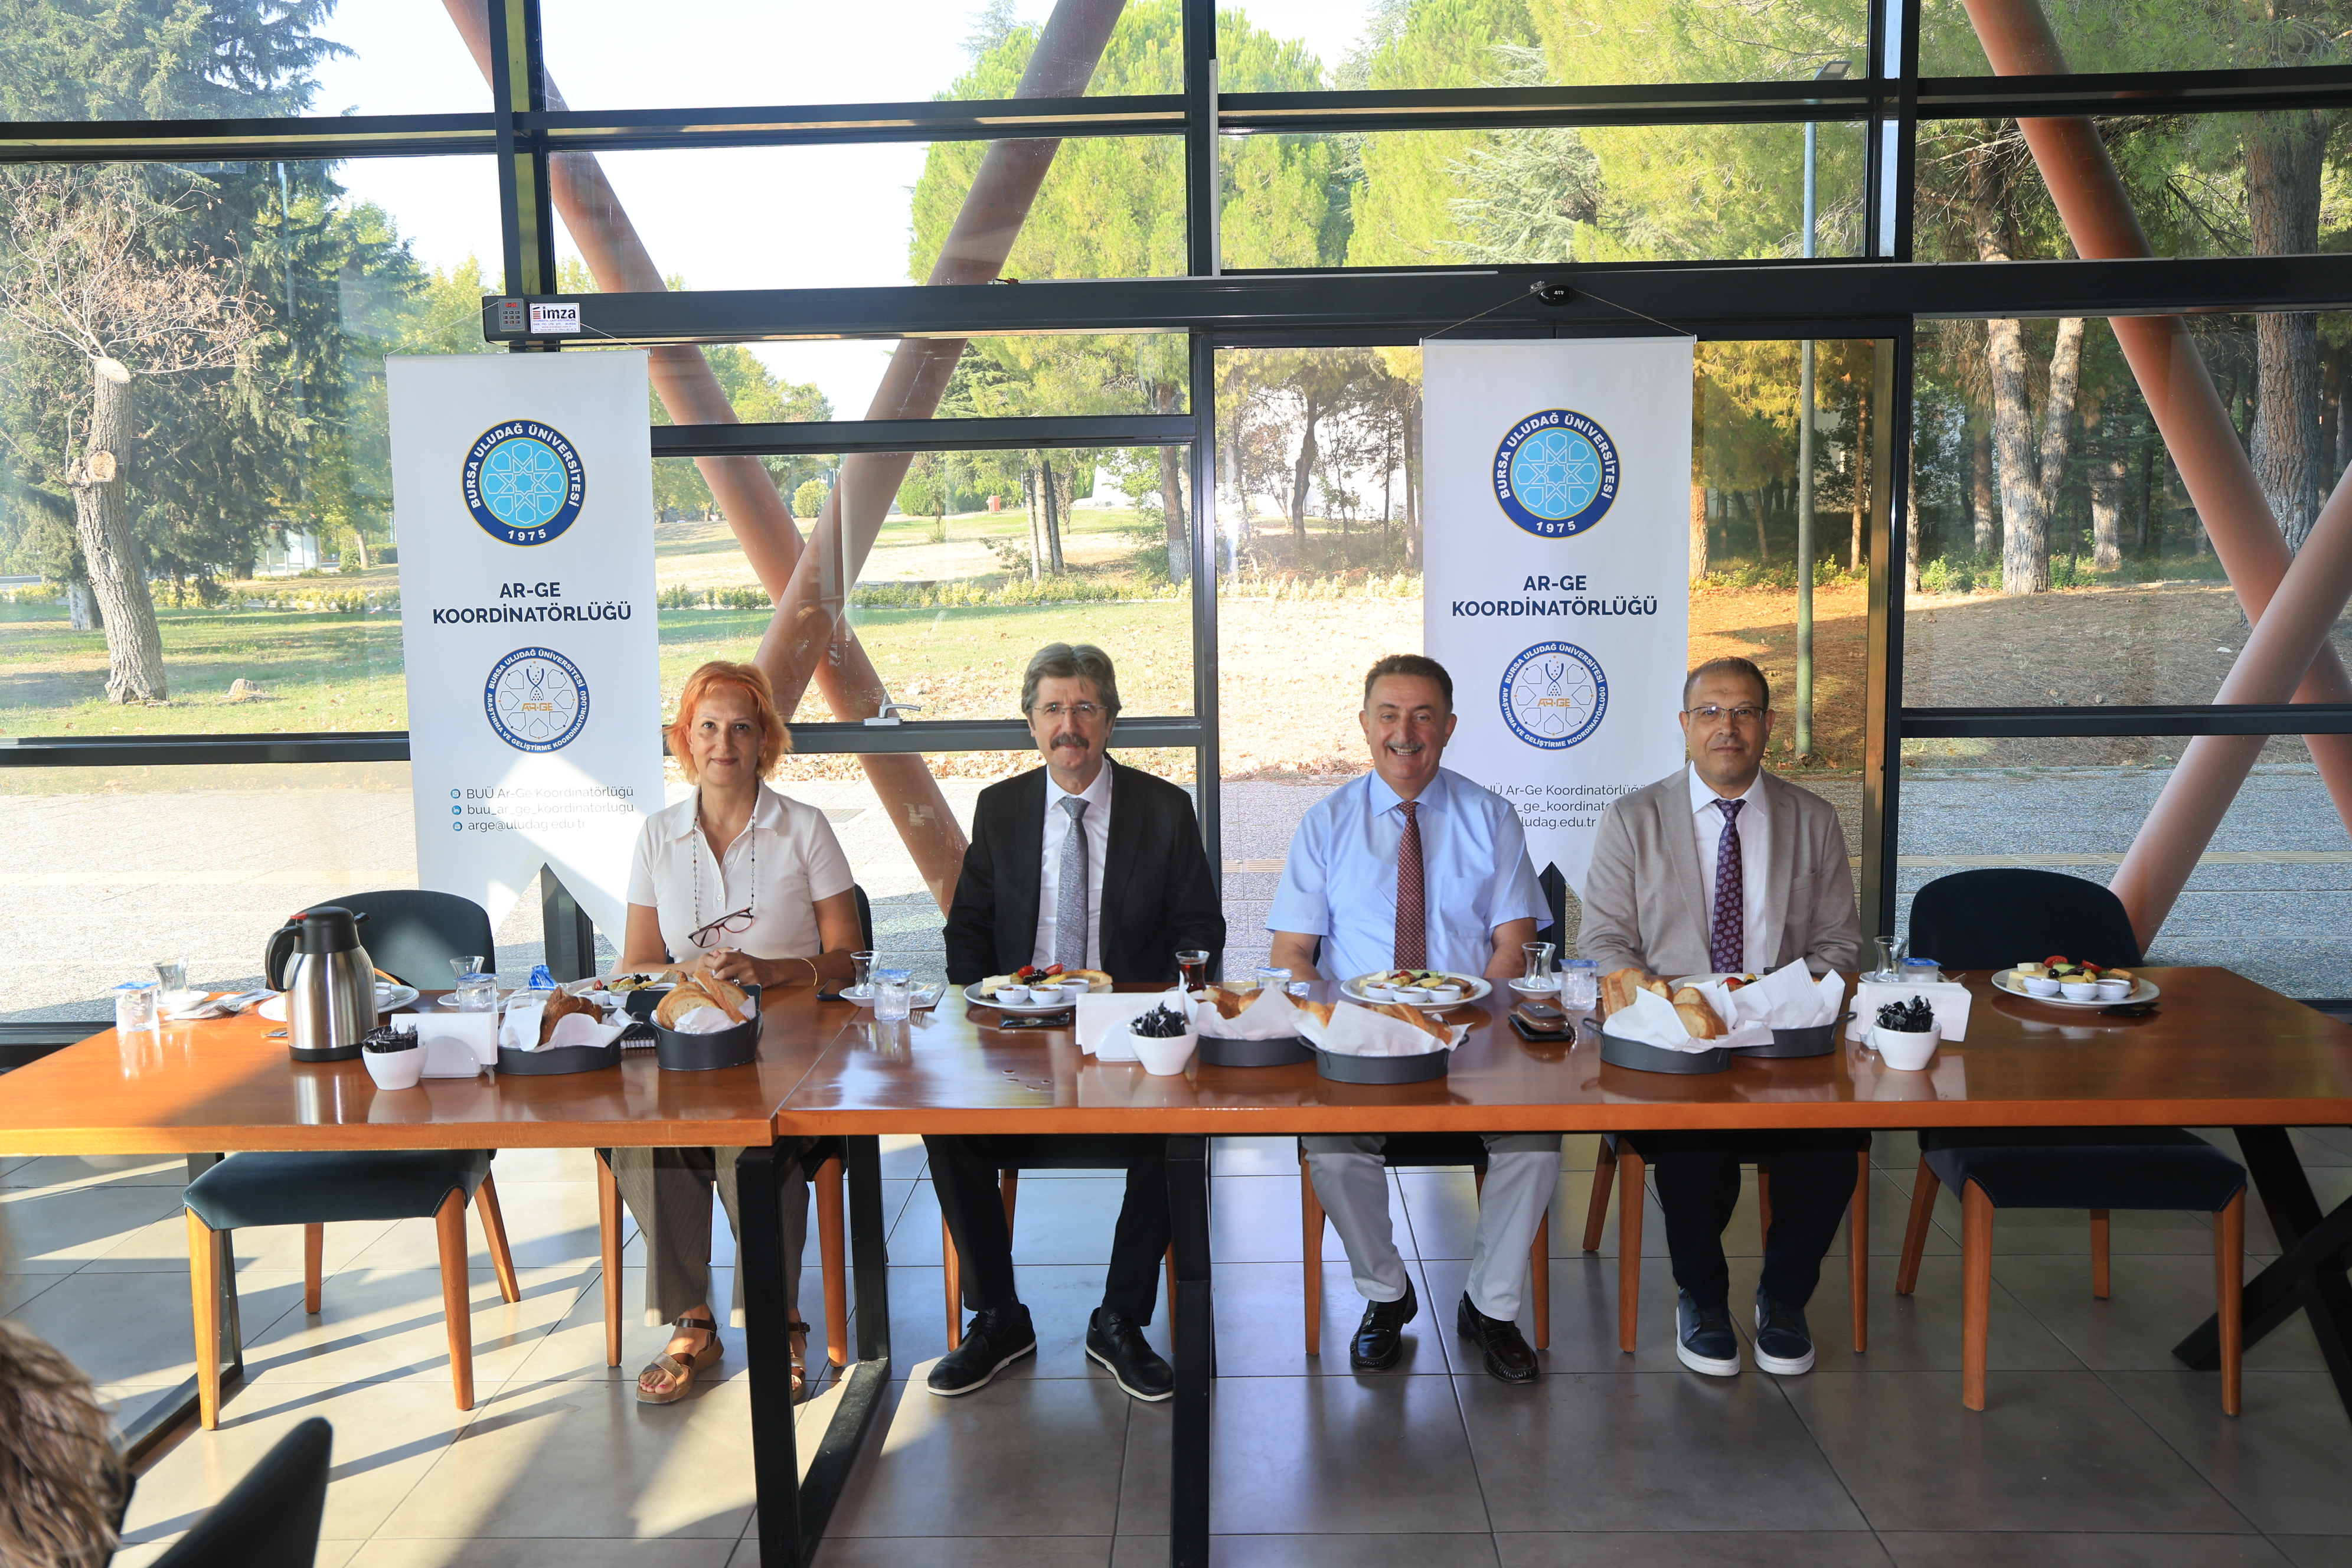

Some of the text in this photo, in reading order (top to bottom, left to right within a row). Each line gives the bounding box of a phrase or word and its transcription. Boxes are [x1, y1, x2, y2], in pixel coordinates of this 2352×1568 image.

[543, 306, 576, 319] imza
[1497, 412, 1615, 499] BURSA ULUDAĞ ÜNİVERSİTESİ
[466, 423, 581, 509] BURSA ULUDAĞ ÜNİVERSİTESİ
[1536, 521, 1576, 533] 1975
[508, 529, 547, 541] 1975
[499, 582, 561, 599] AR-GE
[1523, 575, 1587, 591] AR-GE
[433, 600, 632, 624] KOORDİNATÖRLÜĞÜ
[1452, 595, 1657, 616] KOORDİNATÖRLÜĞÜ
[489, 649, 586, 689] BURSA ULUDAĞ ÜNİVERSİTESİ
[1504, 643, 1605, 684] BURSA ULUDAĞ ÜNİVERSİTESİ
[521, 703, 553, 711] AR-GE
[1537, 698, 1570, 707] AR-GE
[487, 690, 587, 751] ARAŞTIRMA VE GELİŞTİRME KOORDİNATÖRLÜĞÜ
[1502, 686, 1606, 747] ARAŞTIRMA VE GELİŞTİRME KOORDİNATÖRLÜĞÜ
[466, 786, 634, 799] BUÜ Ar-Ge Koordinatörlüğü
[1505, 785, 1542, 795] Ar-Ge
[1546, 784, 1645, 795] Koordinatörlü
[467, 802, 634, 816] buu_ar_ge_koordinatorlugu
[468, 819, 586, 832] arge@uludag.edu.tr
[1521, 816, 1596, 829] ludag.edu.tr
